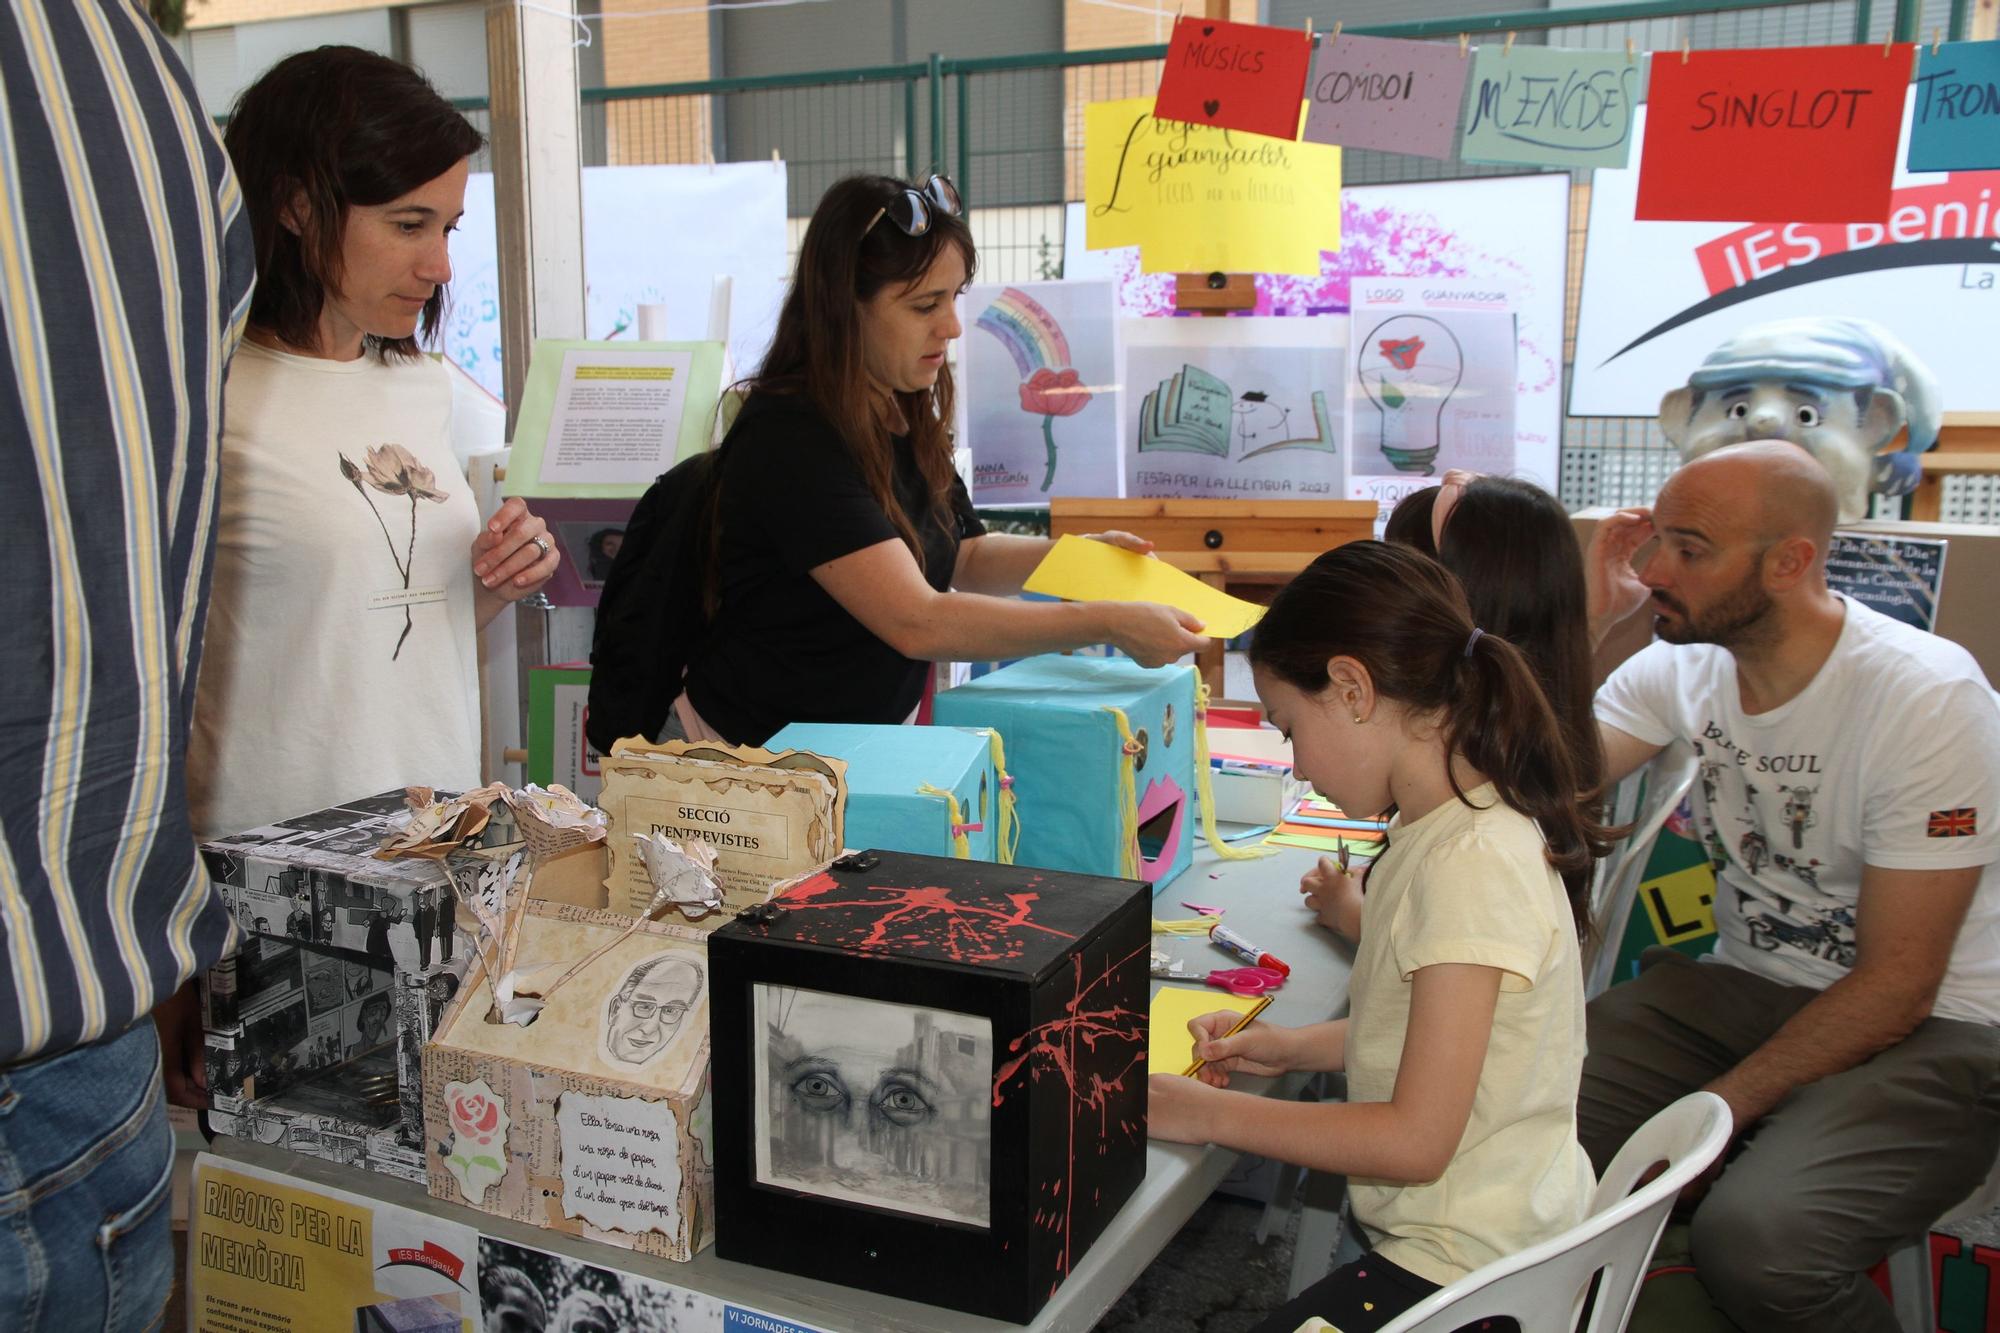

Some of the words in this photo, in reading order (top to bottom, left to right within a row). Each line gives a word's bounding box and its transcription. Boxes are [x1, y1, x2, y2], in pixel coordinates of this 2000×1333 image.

[1724, 222, 1821, 287] IES
[1366, 289, 1404, 301] LOGO
[975, 462, 1007, 473] ANNA
[1137, 471, 1172, 486] FESTA
[1174, 474, 1199, 487] PER
[1206, 475, 1225, 489] LA
[1756, 755, 1821, 773] SOUL
[678, 807, 730, 824] SECCIÓ
[580, 1113, 602, 1127] Ella
[626, 1127, 640, 1136] una
[579, 1144, 594, 1154] una
[619, 1147, 628, 1159] de
[594, 1172, 616, 1187] paper
[635, 1175, 643, 1187] de
[204, 1180, 284, 1234] RACONS
[291, 1203, 331, 1247] PER
[337, 1216, 364, 1256] LA
[201, 1233, 305, 1291] MEMÒRIA
[398, 1249, 412, 1260] IES
[415, 1251, 454, 1277] Benigasló
[241, 1305, 252, 1314] per
[729, 1311, 739, 1322] VI
